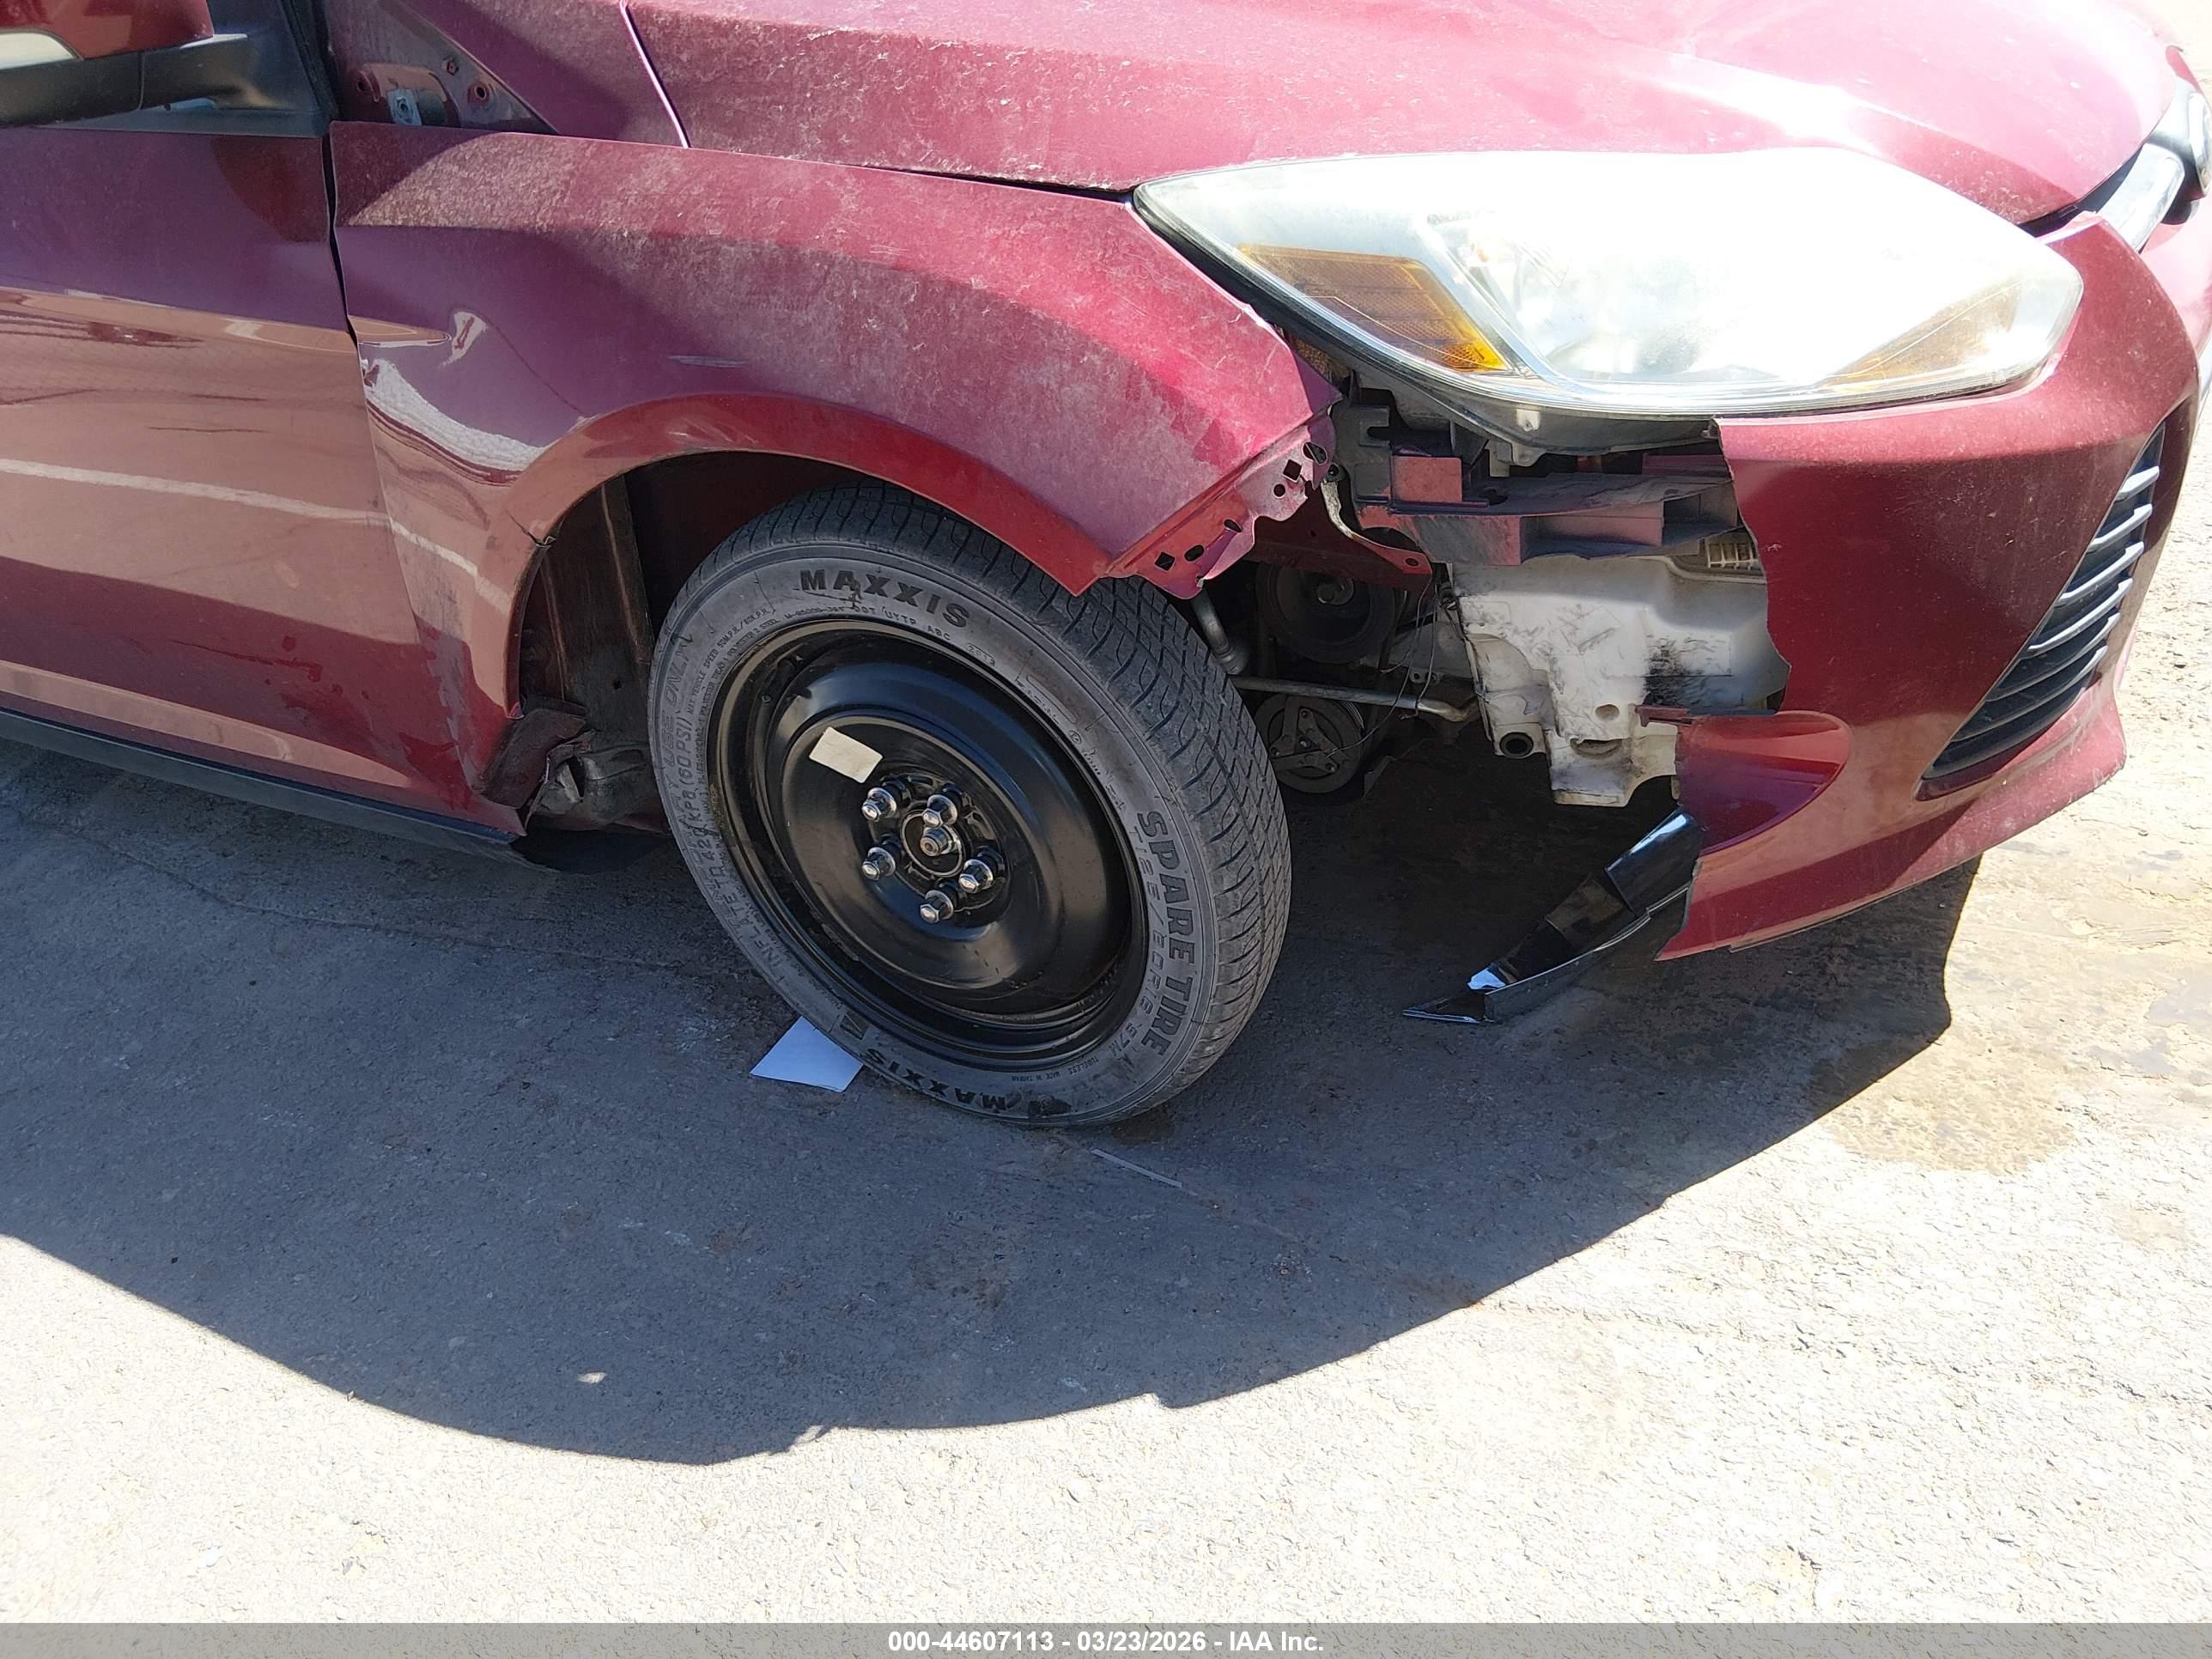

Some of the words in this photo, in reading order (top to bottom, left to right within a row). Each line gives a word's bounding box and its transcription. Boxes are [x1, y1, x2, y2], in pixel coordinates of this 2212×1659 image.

[799, 568, 970, 628] MAXXIS
[852, 605, 876, 615] DOT
[702, 647, 720, 670] SPEED
[659, 708, 676, 768] USE
[1136, 811, 1196, 965] SPARE
[724, 892, 782, 968] INFLATE
[1140, 975, 1194, 1056] TIRE
[865, 1048, 1008, 1111] MAXXIS
